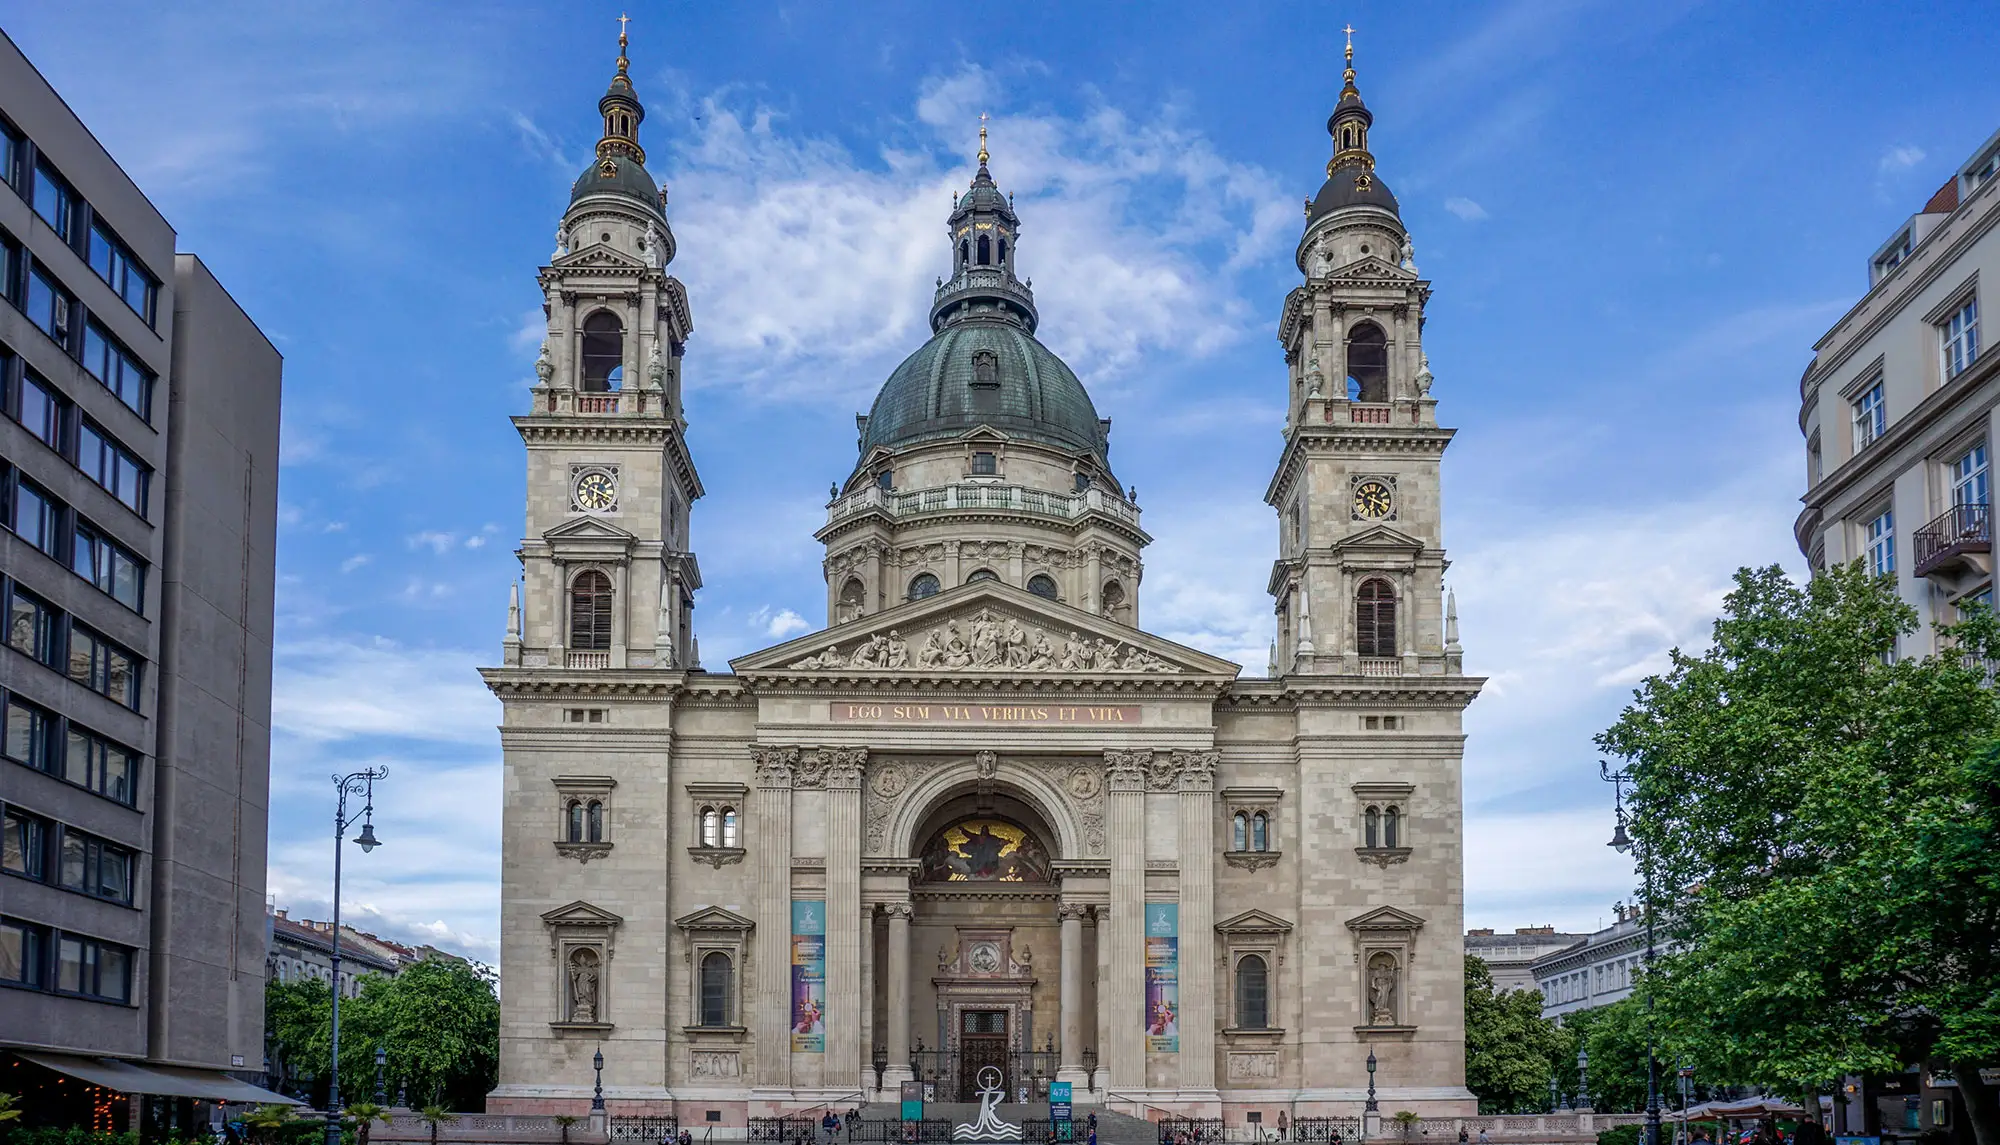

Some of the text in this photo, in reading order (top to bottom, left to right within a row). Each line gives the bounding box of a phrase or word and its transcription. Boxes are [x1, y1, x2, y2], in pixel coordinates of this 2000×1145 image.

[848, 706, 1123, 720] EGO SUM VIA VERITAS ET VITA
[1052, 1088, 1070, 1097] 475
